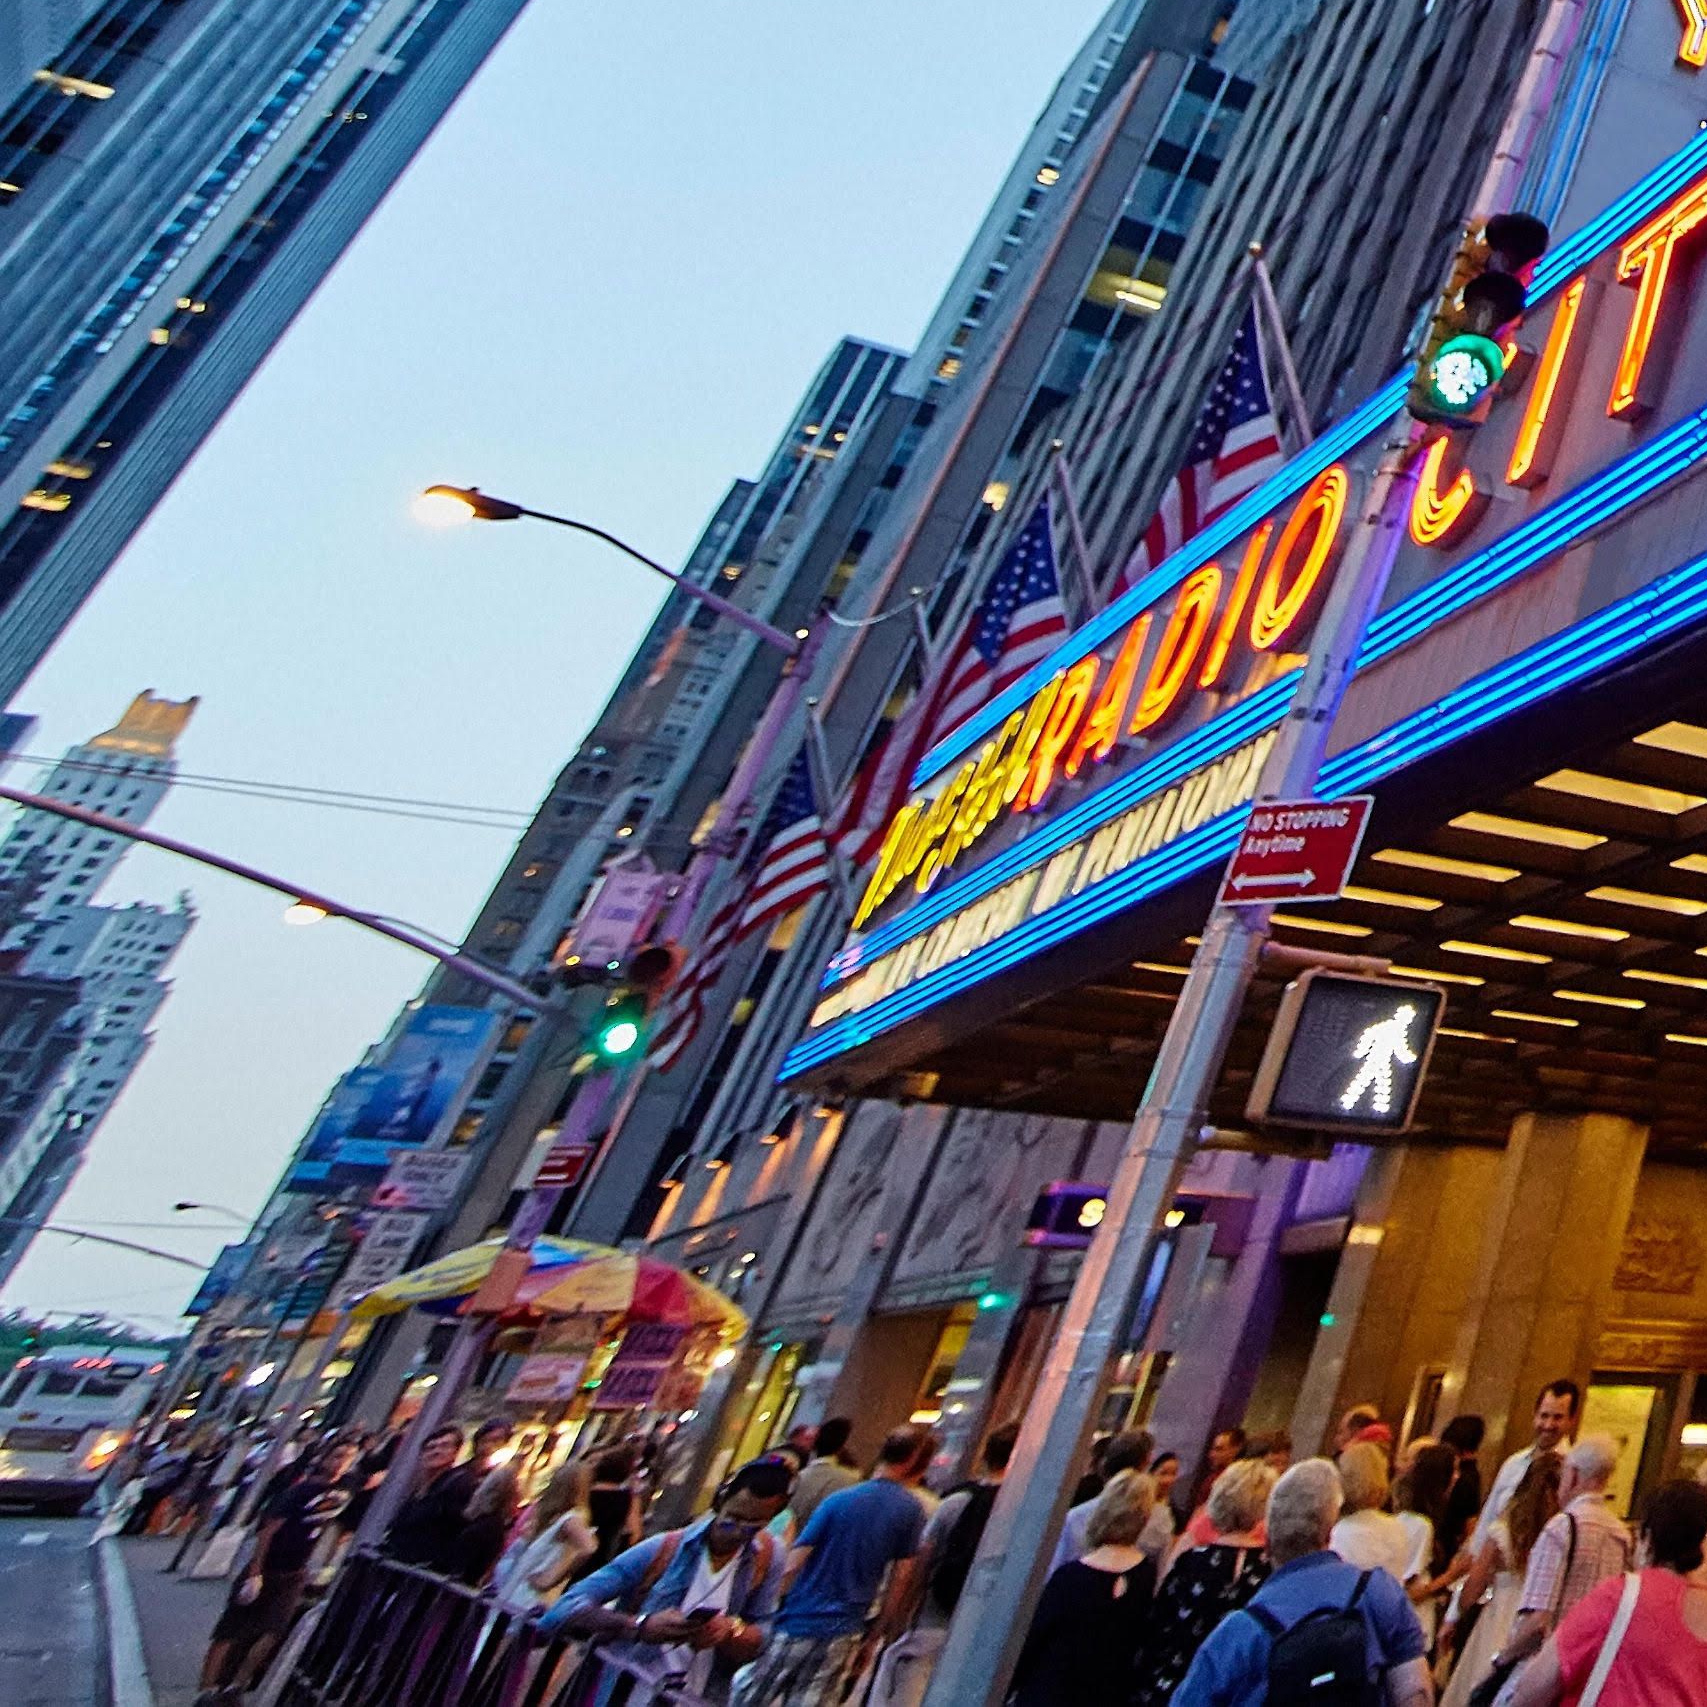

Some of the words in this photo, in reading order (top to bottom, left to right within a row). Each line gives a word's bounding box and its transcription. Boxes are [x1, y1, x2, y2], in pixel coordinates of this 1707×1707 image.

[1011, 462, 1348, 814] RADIO
[1248, 812, 1275, 832] NO
[1273, 807, 1351, 831] STOPPING
